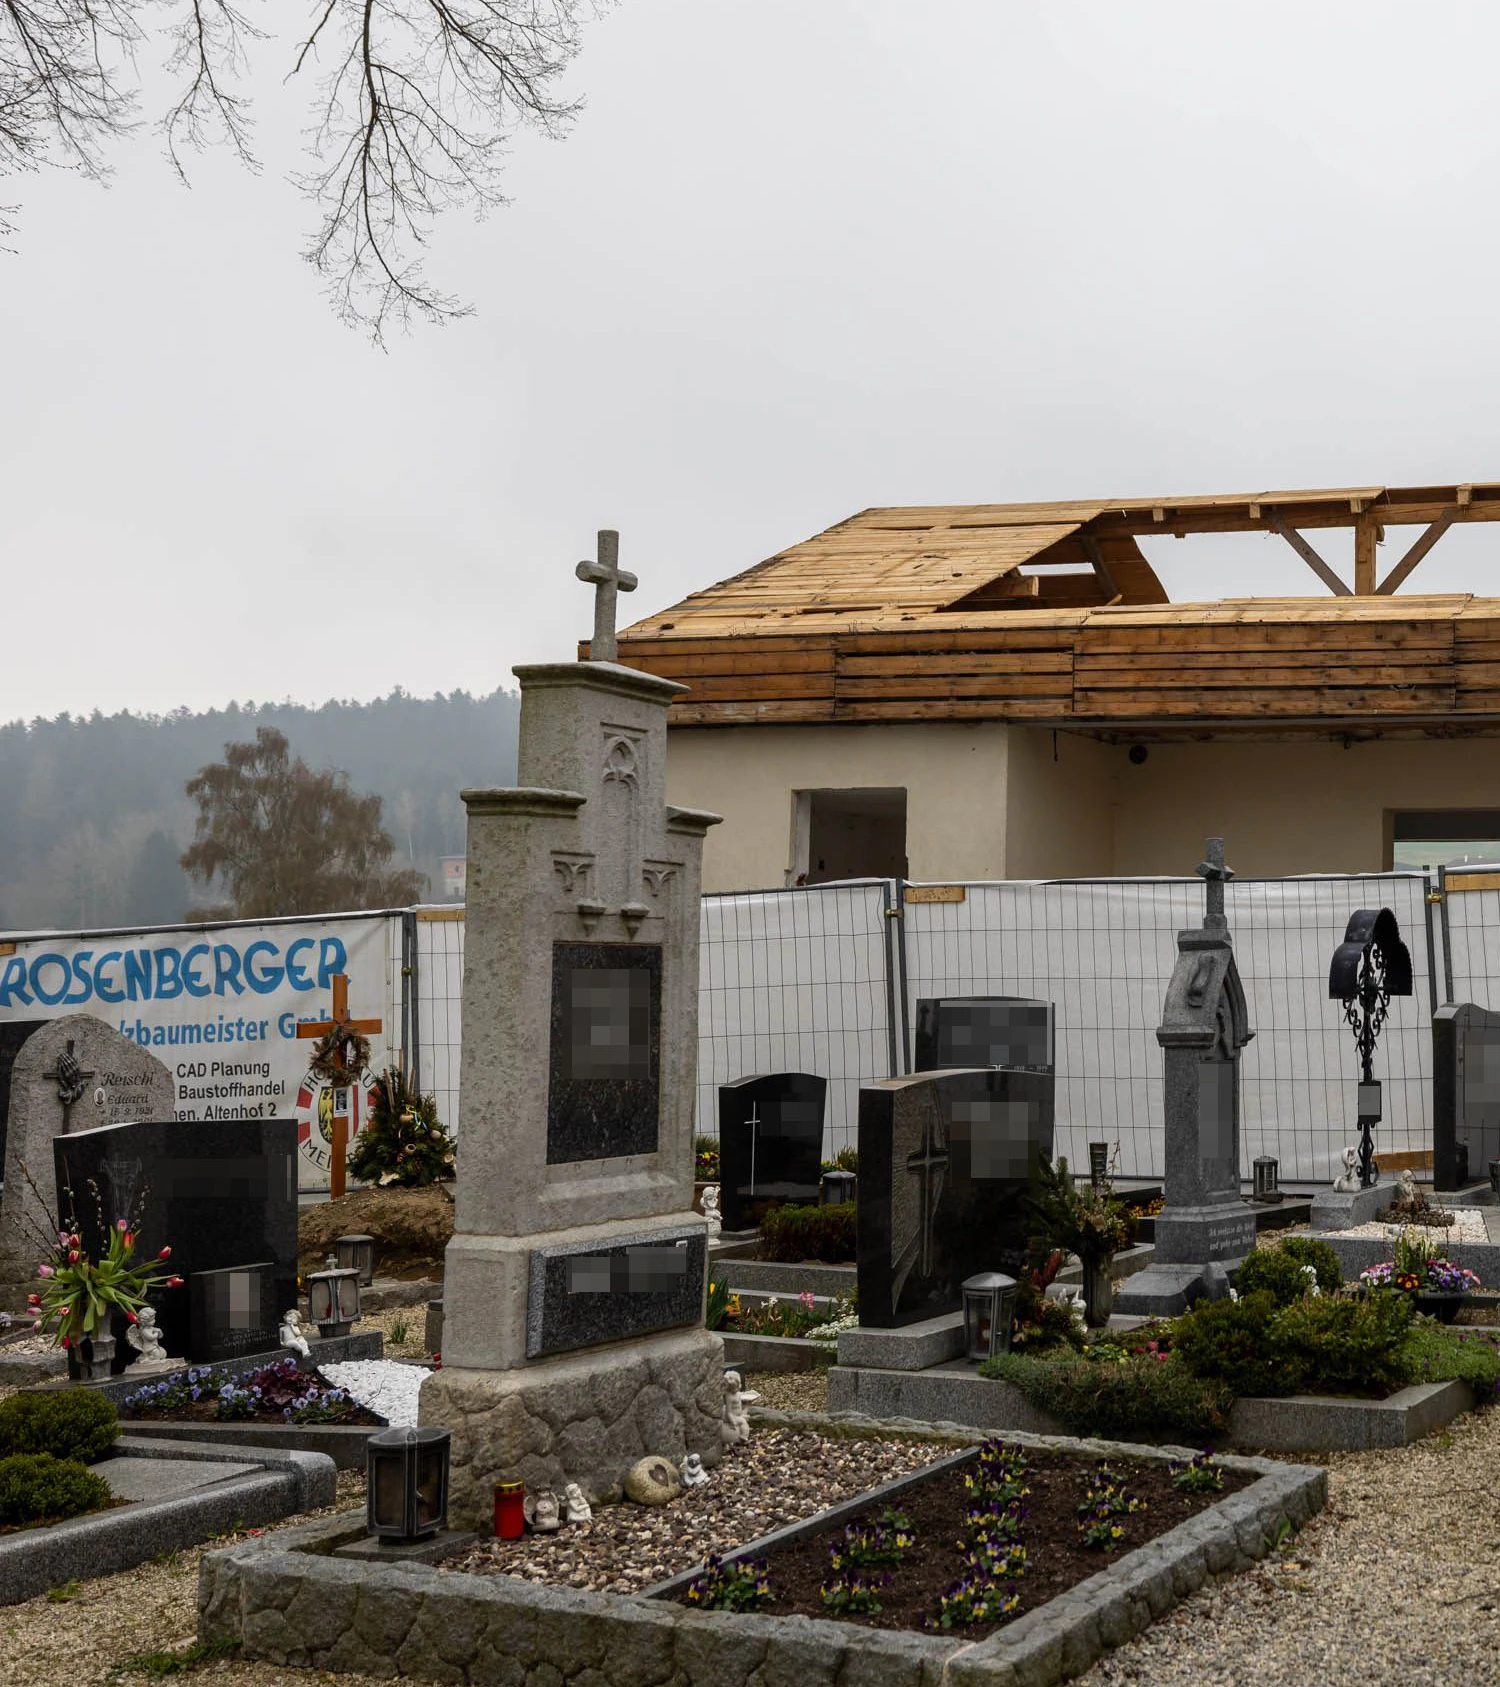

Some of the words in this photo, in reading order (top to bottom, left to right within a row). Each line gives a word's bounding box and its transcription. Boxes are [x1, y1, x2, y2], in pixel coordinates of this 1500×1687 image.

[1, 937, 351, 1007] ROSENBERGER
[177, 1063, 207, 1078] CAD
[211, 1062, 270, 1077] Planung
[179, 1081, 285, 1099] Baustoffhandel
[204, 1104, 263, 1120] Altenhof
[268, 1103, 277, 1116] 2
